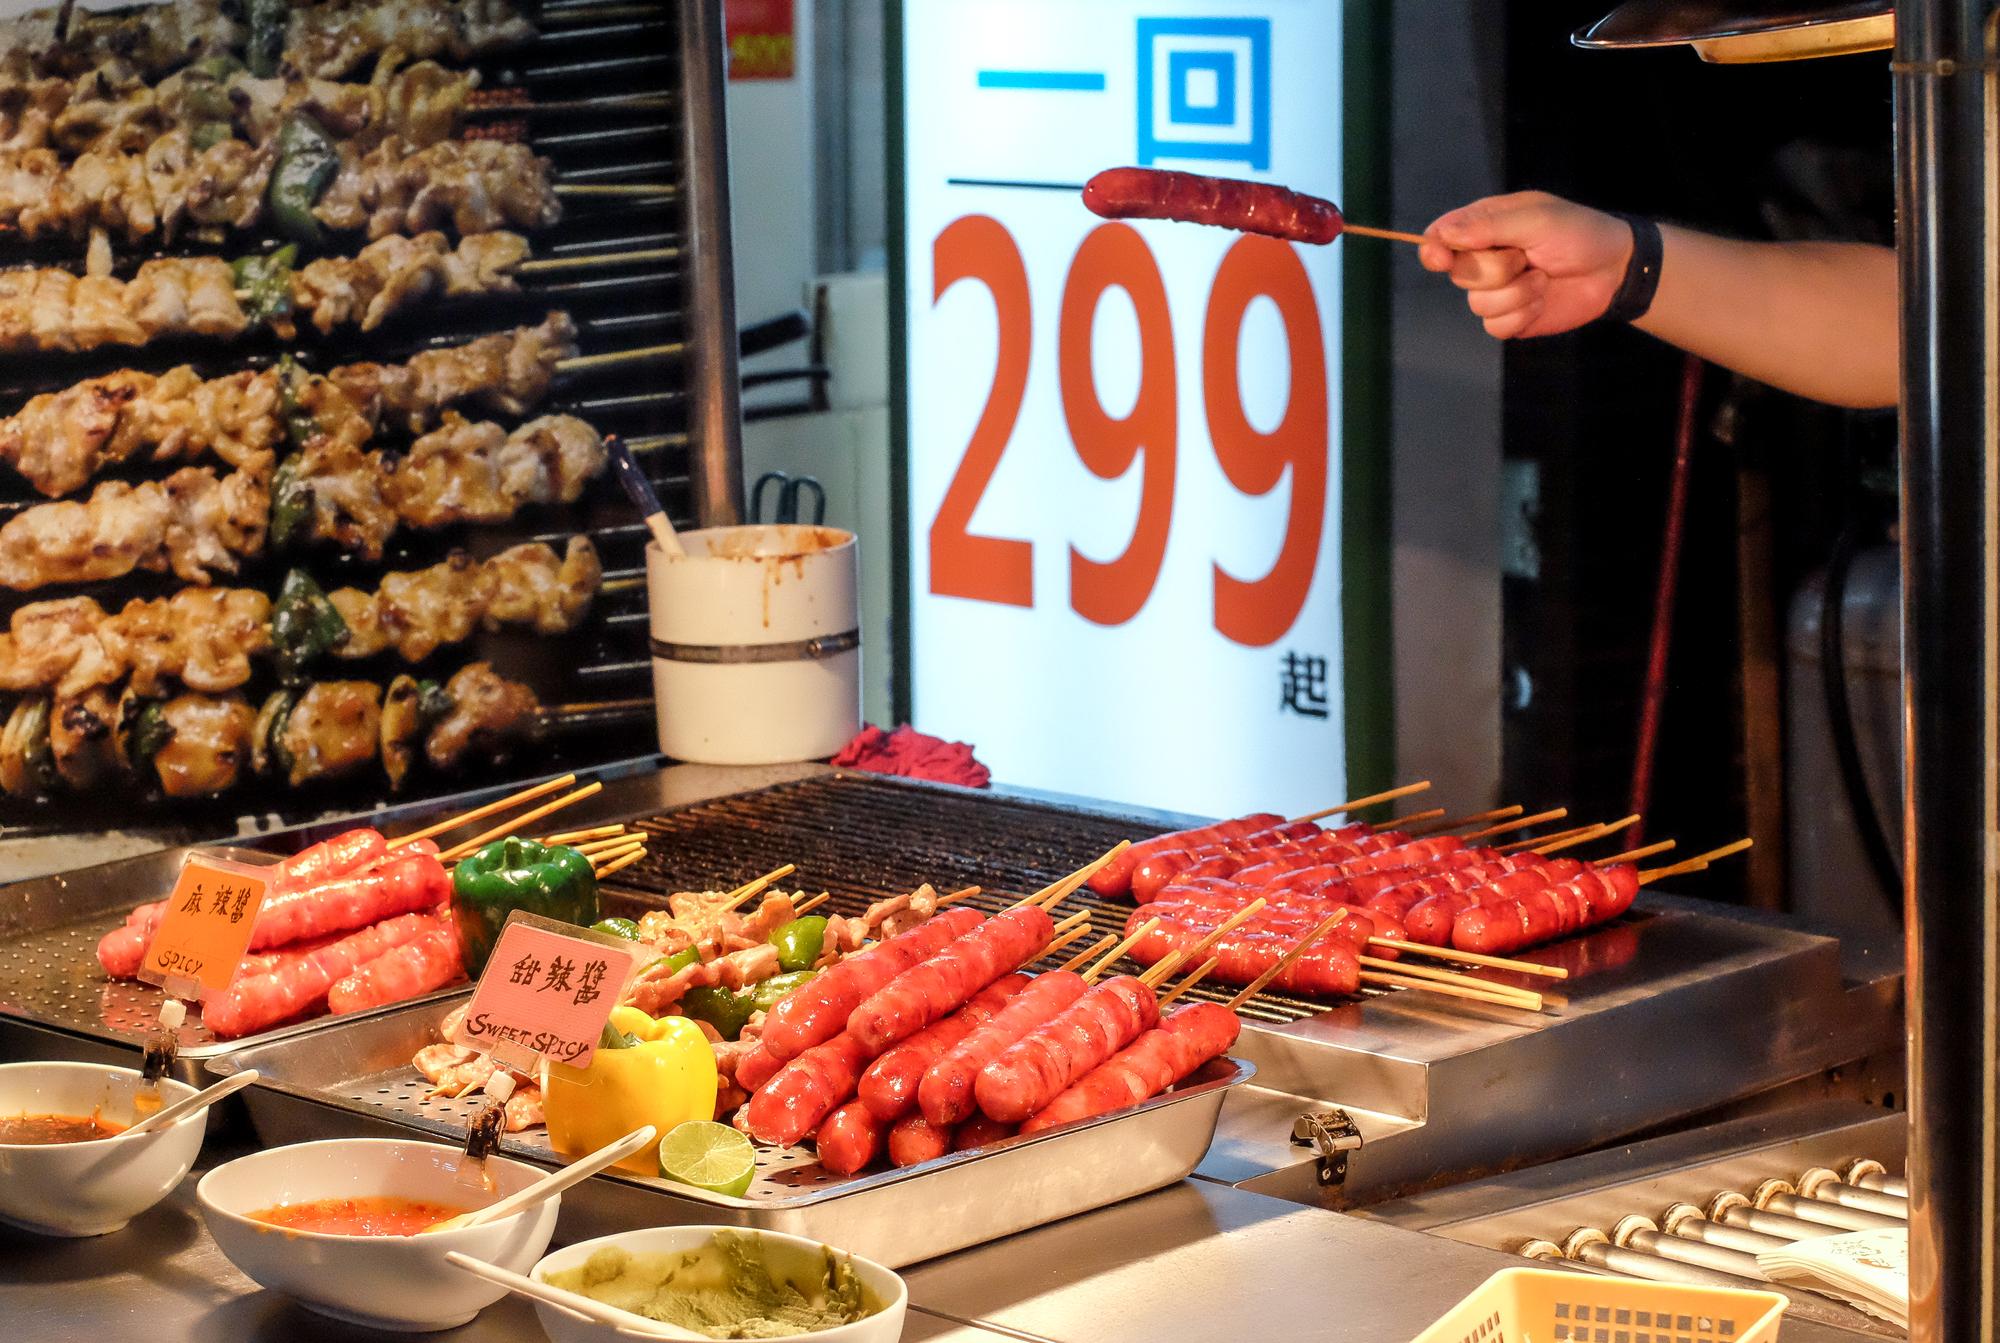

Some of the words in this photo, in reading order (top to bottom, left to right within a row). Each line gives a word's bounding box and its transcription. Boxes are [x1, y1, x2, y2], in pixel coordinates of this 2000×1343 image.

[977, 17, 1271, 171] 一回
[928, 213, 1329, 649] 299
[1279, 651, 1328, 718] 起
[180, 883, 251, 924] 麻辣醬
[157, 950, 203, 975] SPICY
[509, 953, 608, 1006] 甜辣醬
[466, 1013, 532, 1045] SWEET
[530, 1032, 590, 1063] SPICY
